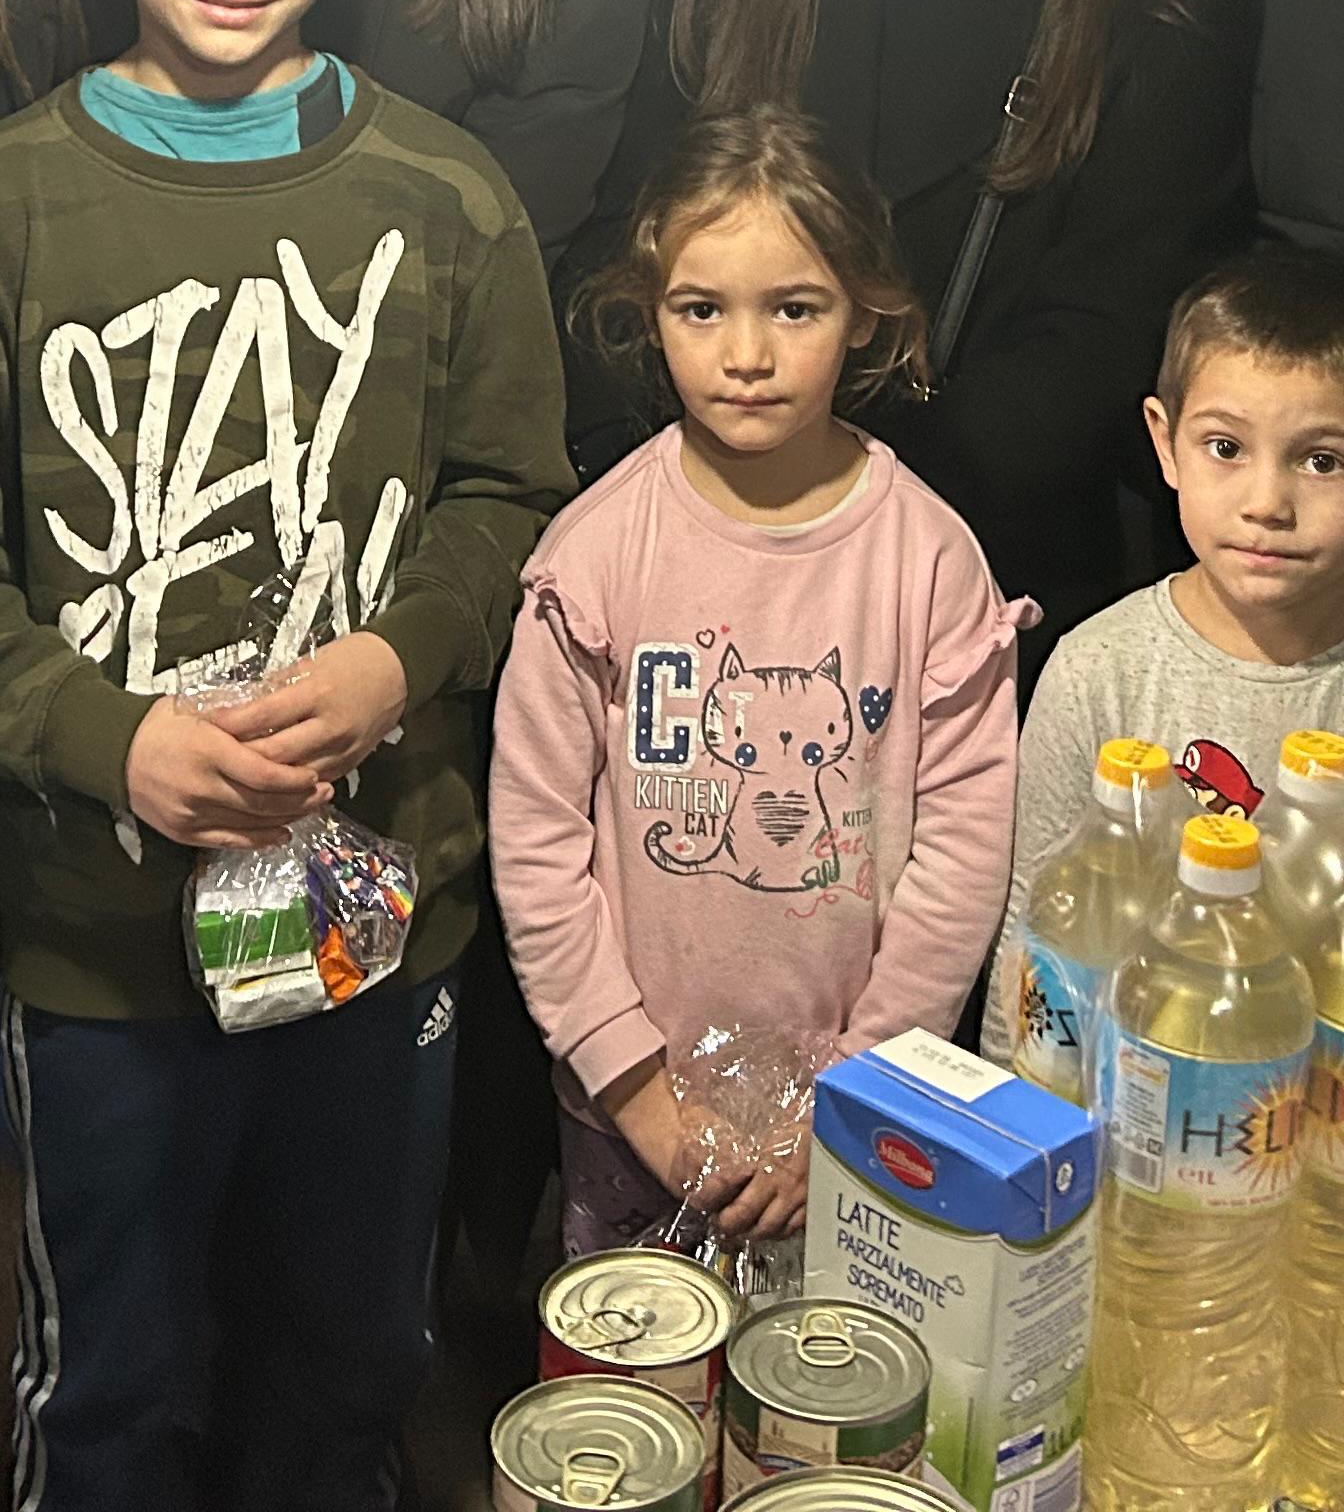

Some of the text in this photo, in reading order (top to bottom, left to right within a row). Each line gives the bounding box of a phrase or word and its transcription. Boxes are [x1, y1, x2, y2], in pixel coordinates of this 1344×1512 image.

[40, 228, 405, 575] STAY
[634, 774, 729, 815] KITTEN
[683, 812, 719, 838] CAT
[416, 1009, 455, 1047] adid
[836, 1192, 902, 1251] LATTE
[836, 1229, 947, 1309] PARZIALMENTE
[846, 1264, 925, 1324] SCREMATO
